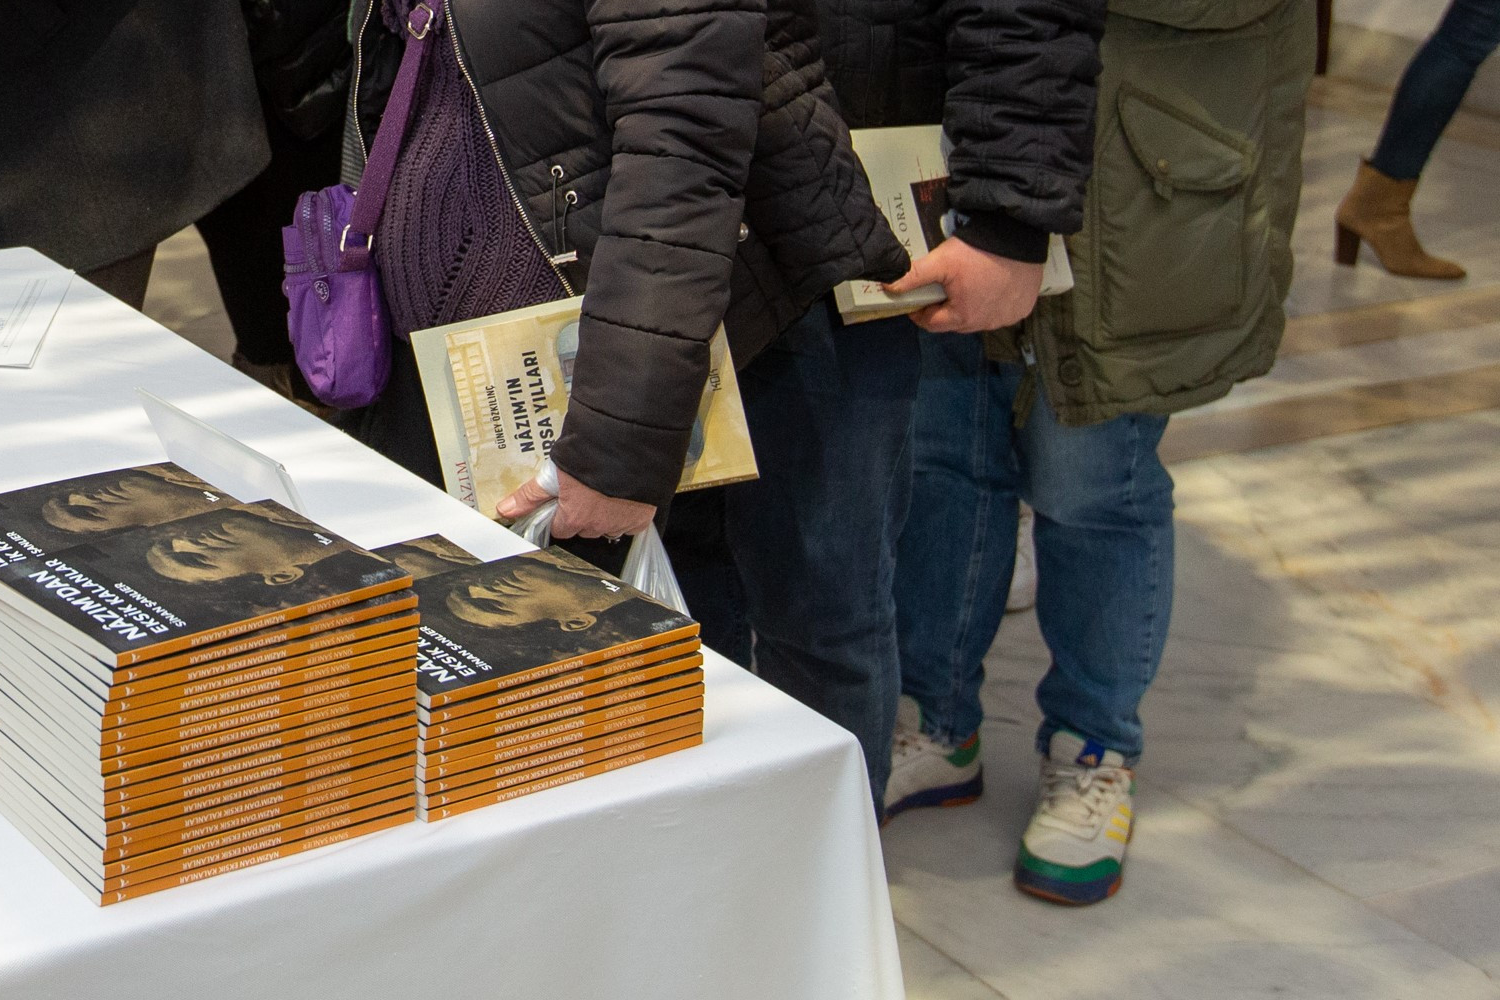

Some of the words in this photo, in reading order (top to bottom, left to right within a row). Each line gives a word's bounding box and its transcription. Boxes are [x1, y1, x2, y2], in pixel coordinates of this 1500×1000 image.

[521, 350, 548, 414] YILLARI
[485, 385, 501, 423] ÖZKILINÇ
[506, 377, 536, 453] NÂZIM'IN
[493, 423, 507, 450] GÜNEY
[6, 531, 43, 554] ŞANLIER
[45, 558, 121, 607] KALANLAR
[114, 581, 156, 608] ŞANLIER
[28, 570, 148, 642] NÂZIM'DAN
[117, 602, 169, 635] EKSİK
[153, 604, 187, 628] SİNAN
[191, 629, 226, 645] KALANLAR
[419, 625, 462, 651] ŞANLIER
[189, 648, 226, 663] KALANLAR
[425, 646, 477, 677] EKSİK
[458, 649, 493, 671] SİNAN
[187, 664, 225, 679] KALANLAR
[497, 672, 530, 687] KALANLAR
[183, 679, 221, 695] KALANLAR
[180, 694, 218, 709] KALANLAR
[497, 689, 530, 704] KALANLAR
[180, 709, 217, 724] KALANLAR
[495, 703, 529, 718] KALANLAR
[179, 722, 217, 737] KALANLAR
[494, 718, 528, 733] KALANLAR
[180, 736, 217, 752] KALANLAR
[495, 732, 529, 747] KALANLAR
[182, 752, 220, 767] KALANLAR
[494, 745, 527, 760] KALANLAR
[182, 767, 220, 783] KALANLAR
[494, 759, 528, 775] KALANLAR
[496, 772, 529, 787] KALANLAR
[183, 780, 221, 796] KALANLAR
[496, 785, 530, 800] KALANLAR
[183, 795, 220, 811] KALANLAR
[184, 809, 222, 826] KALANLAR
[181, 823, 218, 839] KALANLAR
[182, 837, 220, 853] KALANLAR
[182, 852, 220, 869] KALANLAR
[179, 866, 217, 883] KALANLAR
